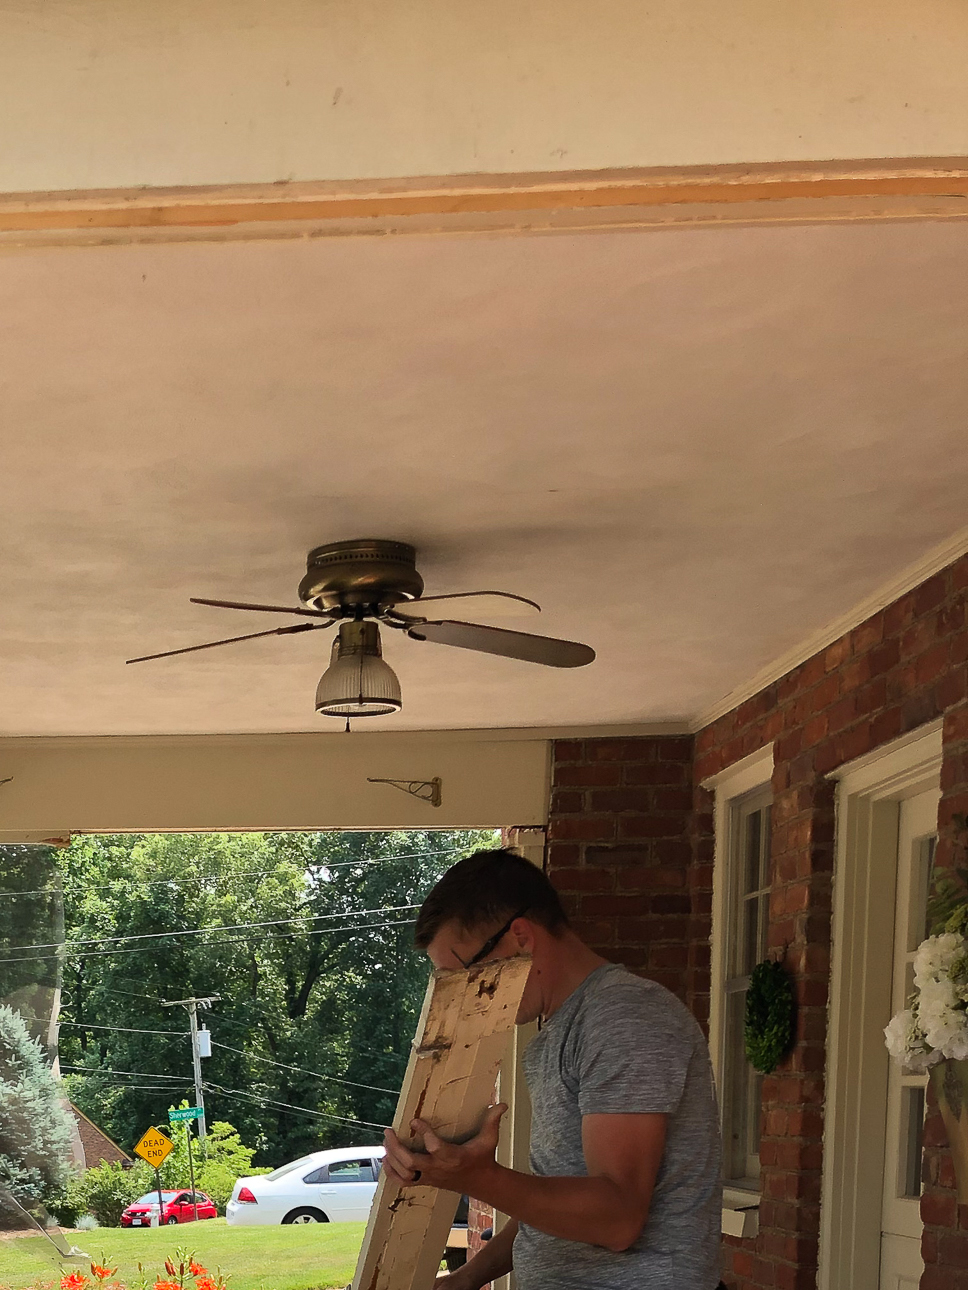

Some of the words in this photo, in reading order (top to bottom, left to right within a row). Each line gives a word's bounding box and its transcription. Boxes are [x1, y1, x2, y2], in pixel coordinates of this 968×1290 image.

[169, 1110, 196, 1119] Sherwood
[144, 1139, 164, 1148] DEAD
[148, 1150, 164, 1158] END
